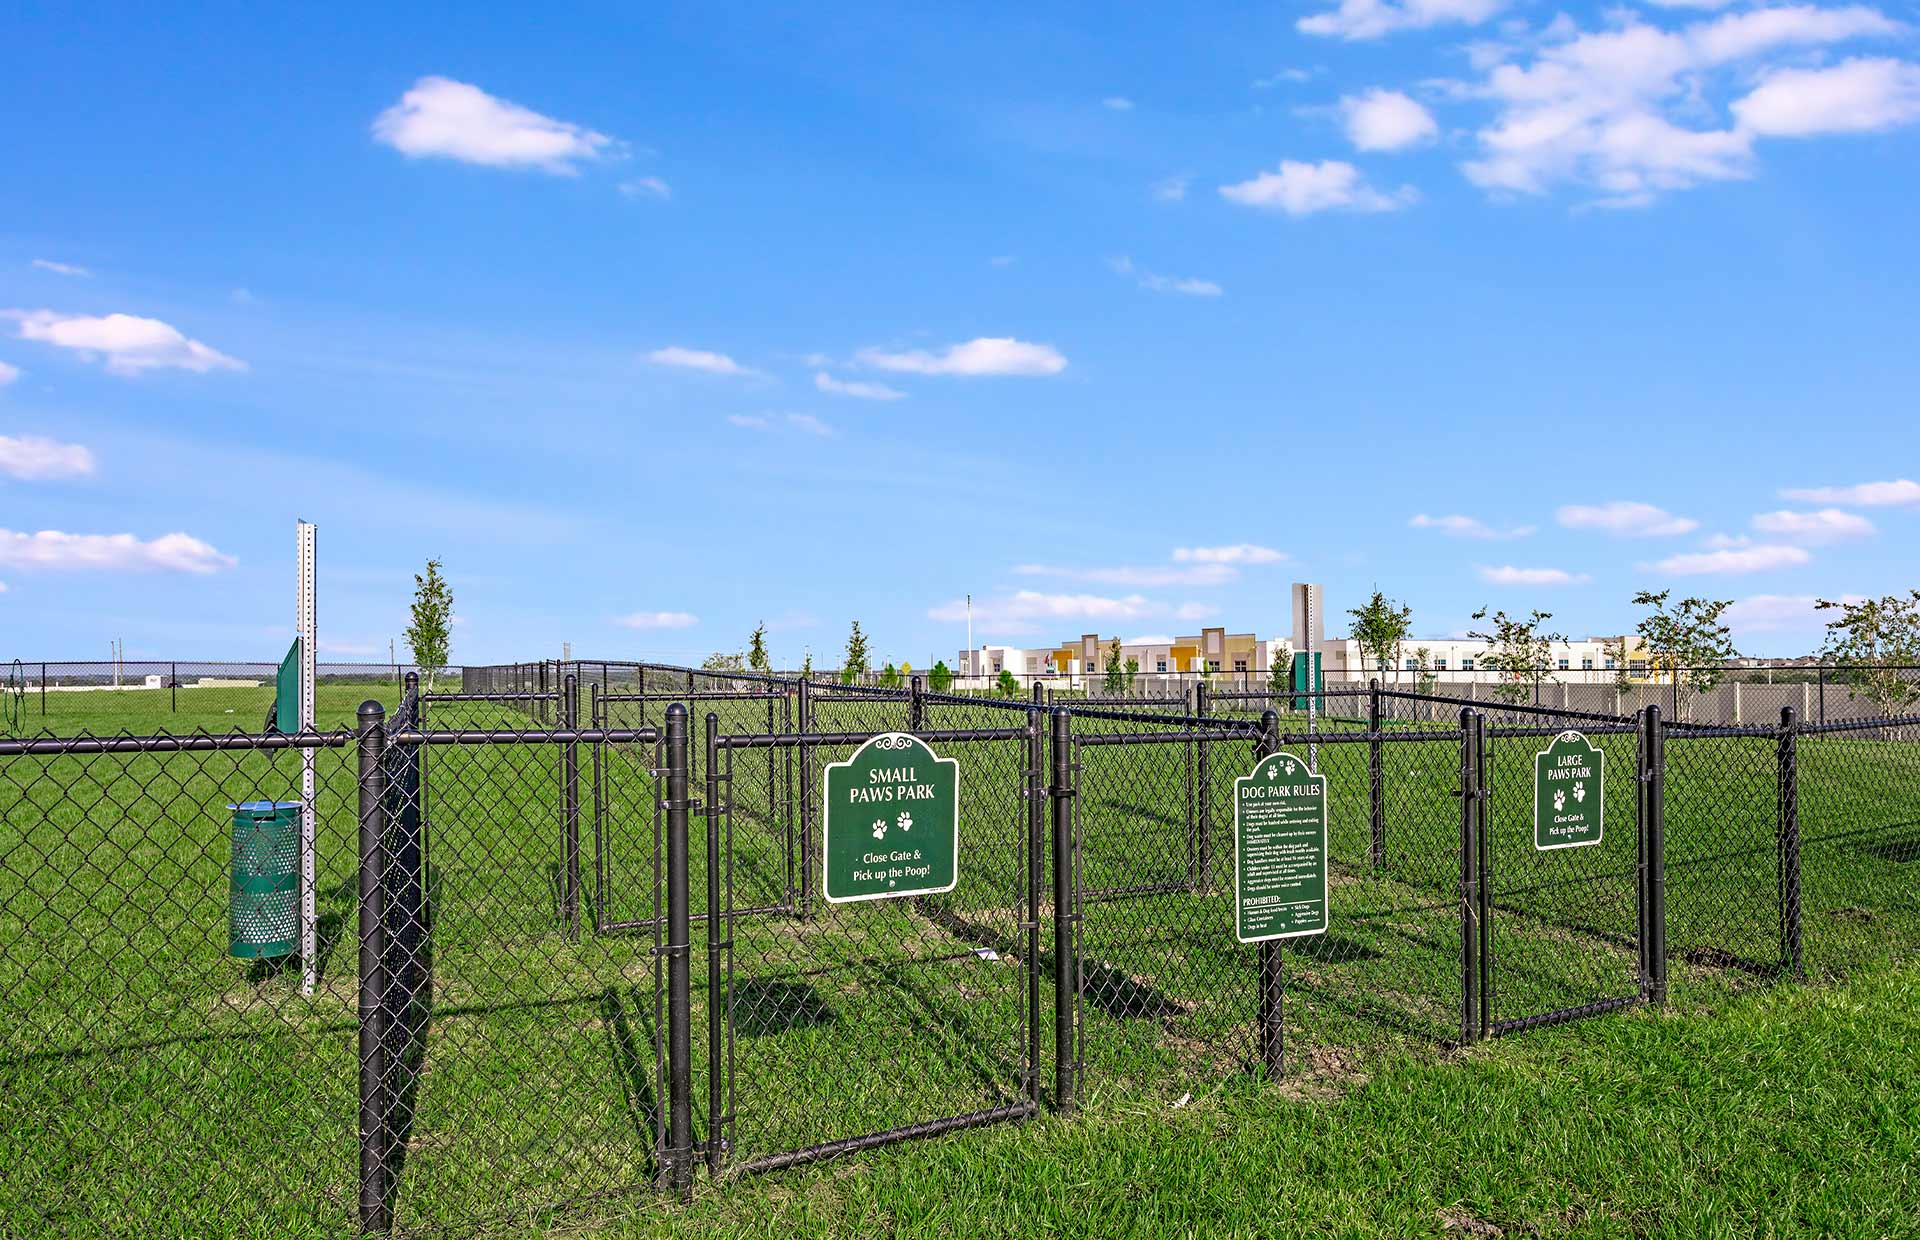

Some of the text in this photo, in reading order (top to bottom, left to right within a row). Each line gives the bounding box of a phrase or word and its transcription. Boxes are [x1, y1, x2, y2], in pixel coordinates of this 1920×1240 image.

[1557, 754, 1582, 766] LARGE
[869, 767, 917, 784] SMALL
[1548, 767, 1591, 780] PAWS PARK
[850, 784, 935, 803] PAWS PARK
[1242, 784, 1320, 798] DOG PARK RULES
[1554, 815, 1567, 823] Close
[1568, 814, 1580, 822] Gate
[1549, 827, 1559, 835] Pick
[1567, 825, 1575, 833] the
[1575, 824, 1589, 834] Poop!
[863, 849, 921, 863] Close Gate &
[853, 864, 930, 881] Pick up the Poop!
[1244, 896, 1280, 906] PROHIBITED:
